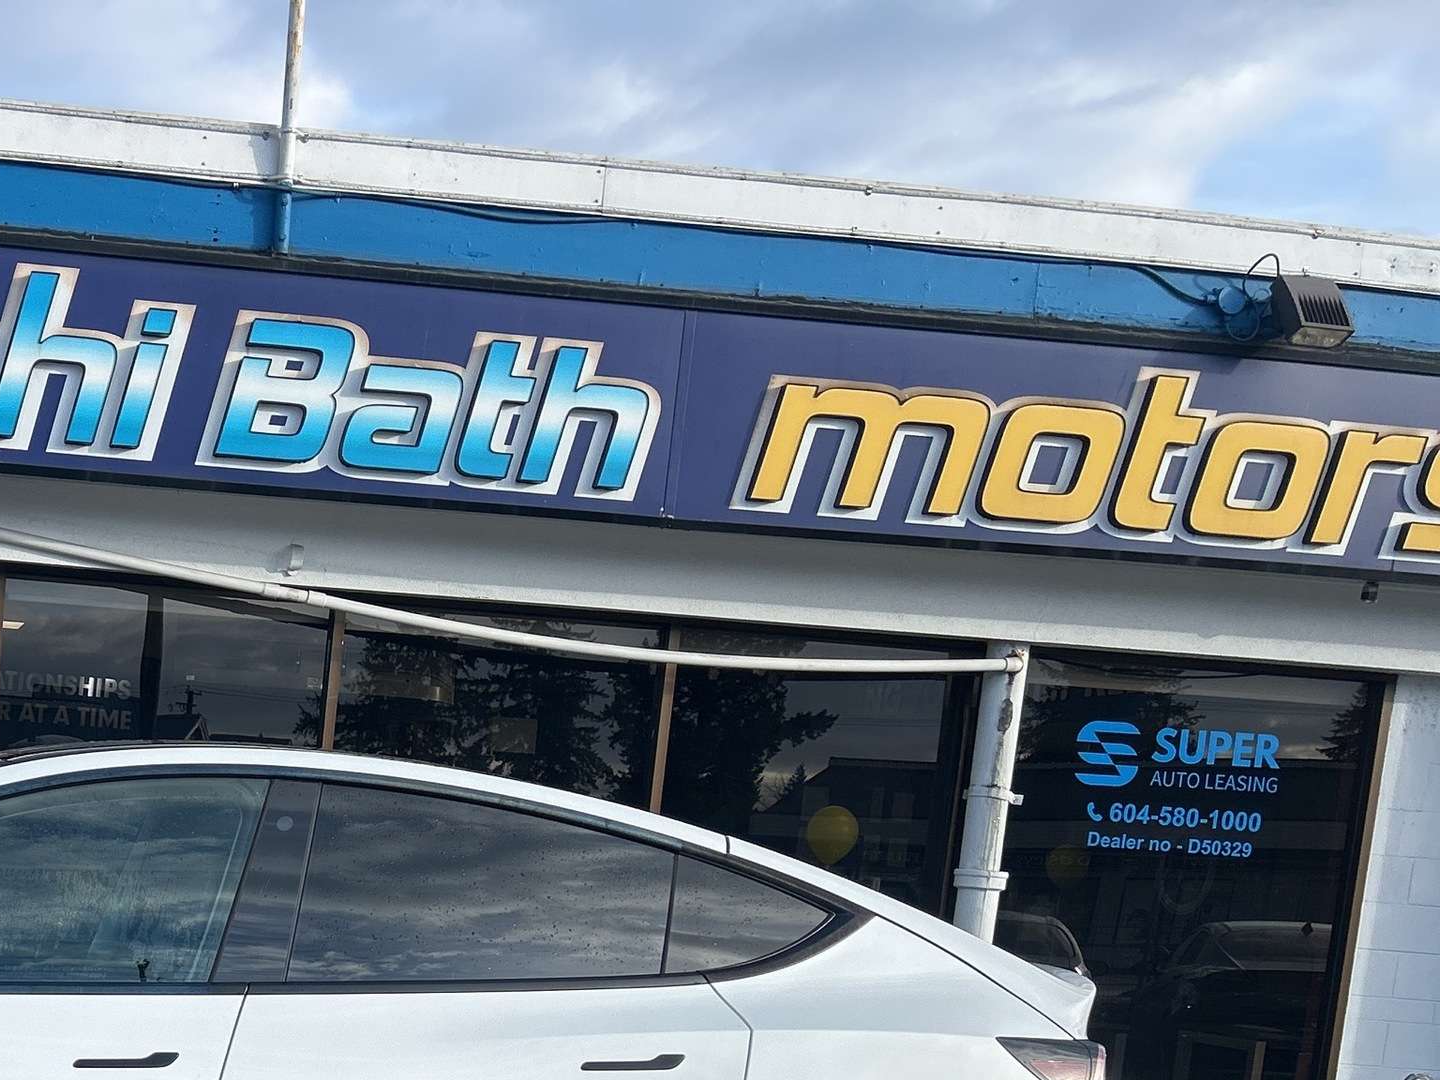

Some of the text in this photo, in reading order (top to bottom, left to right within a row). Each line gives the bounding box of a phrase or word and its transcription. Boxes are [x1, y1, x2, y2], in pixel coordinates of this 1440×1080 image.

[195, 309, 662, 502] Bath
[18, 703, 49, 723] AT
[53, 704, 70, 725] A
[78, 706, 132, 730] TIME
[1151, 727, 1281, 769] SUPER
[1150, 770, 1279, 794] AUTO LEASING
[1109, 802, 1262, 833] 604-580-1000
[1087, 831, 1144, 850] Dealer
[1149, 840, 1171, 852] no
[1187, 838, 1253, 858] D50329
